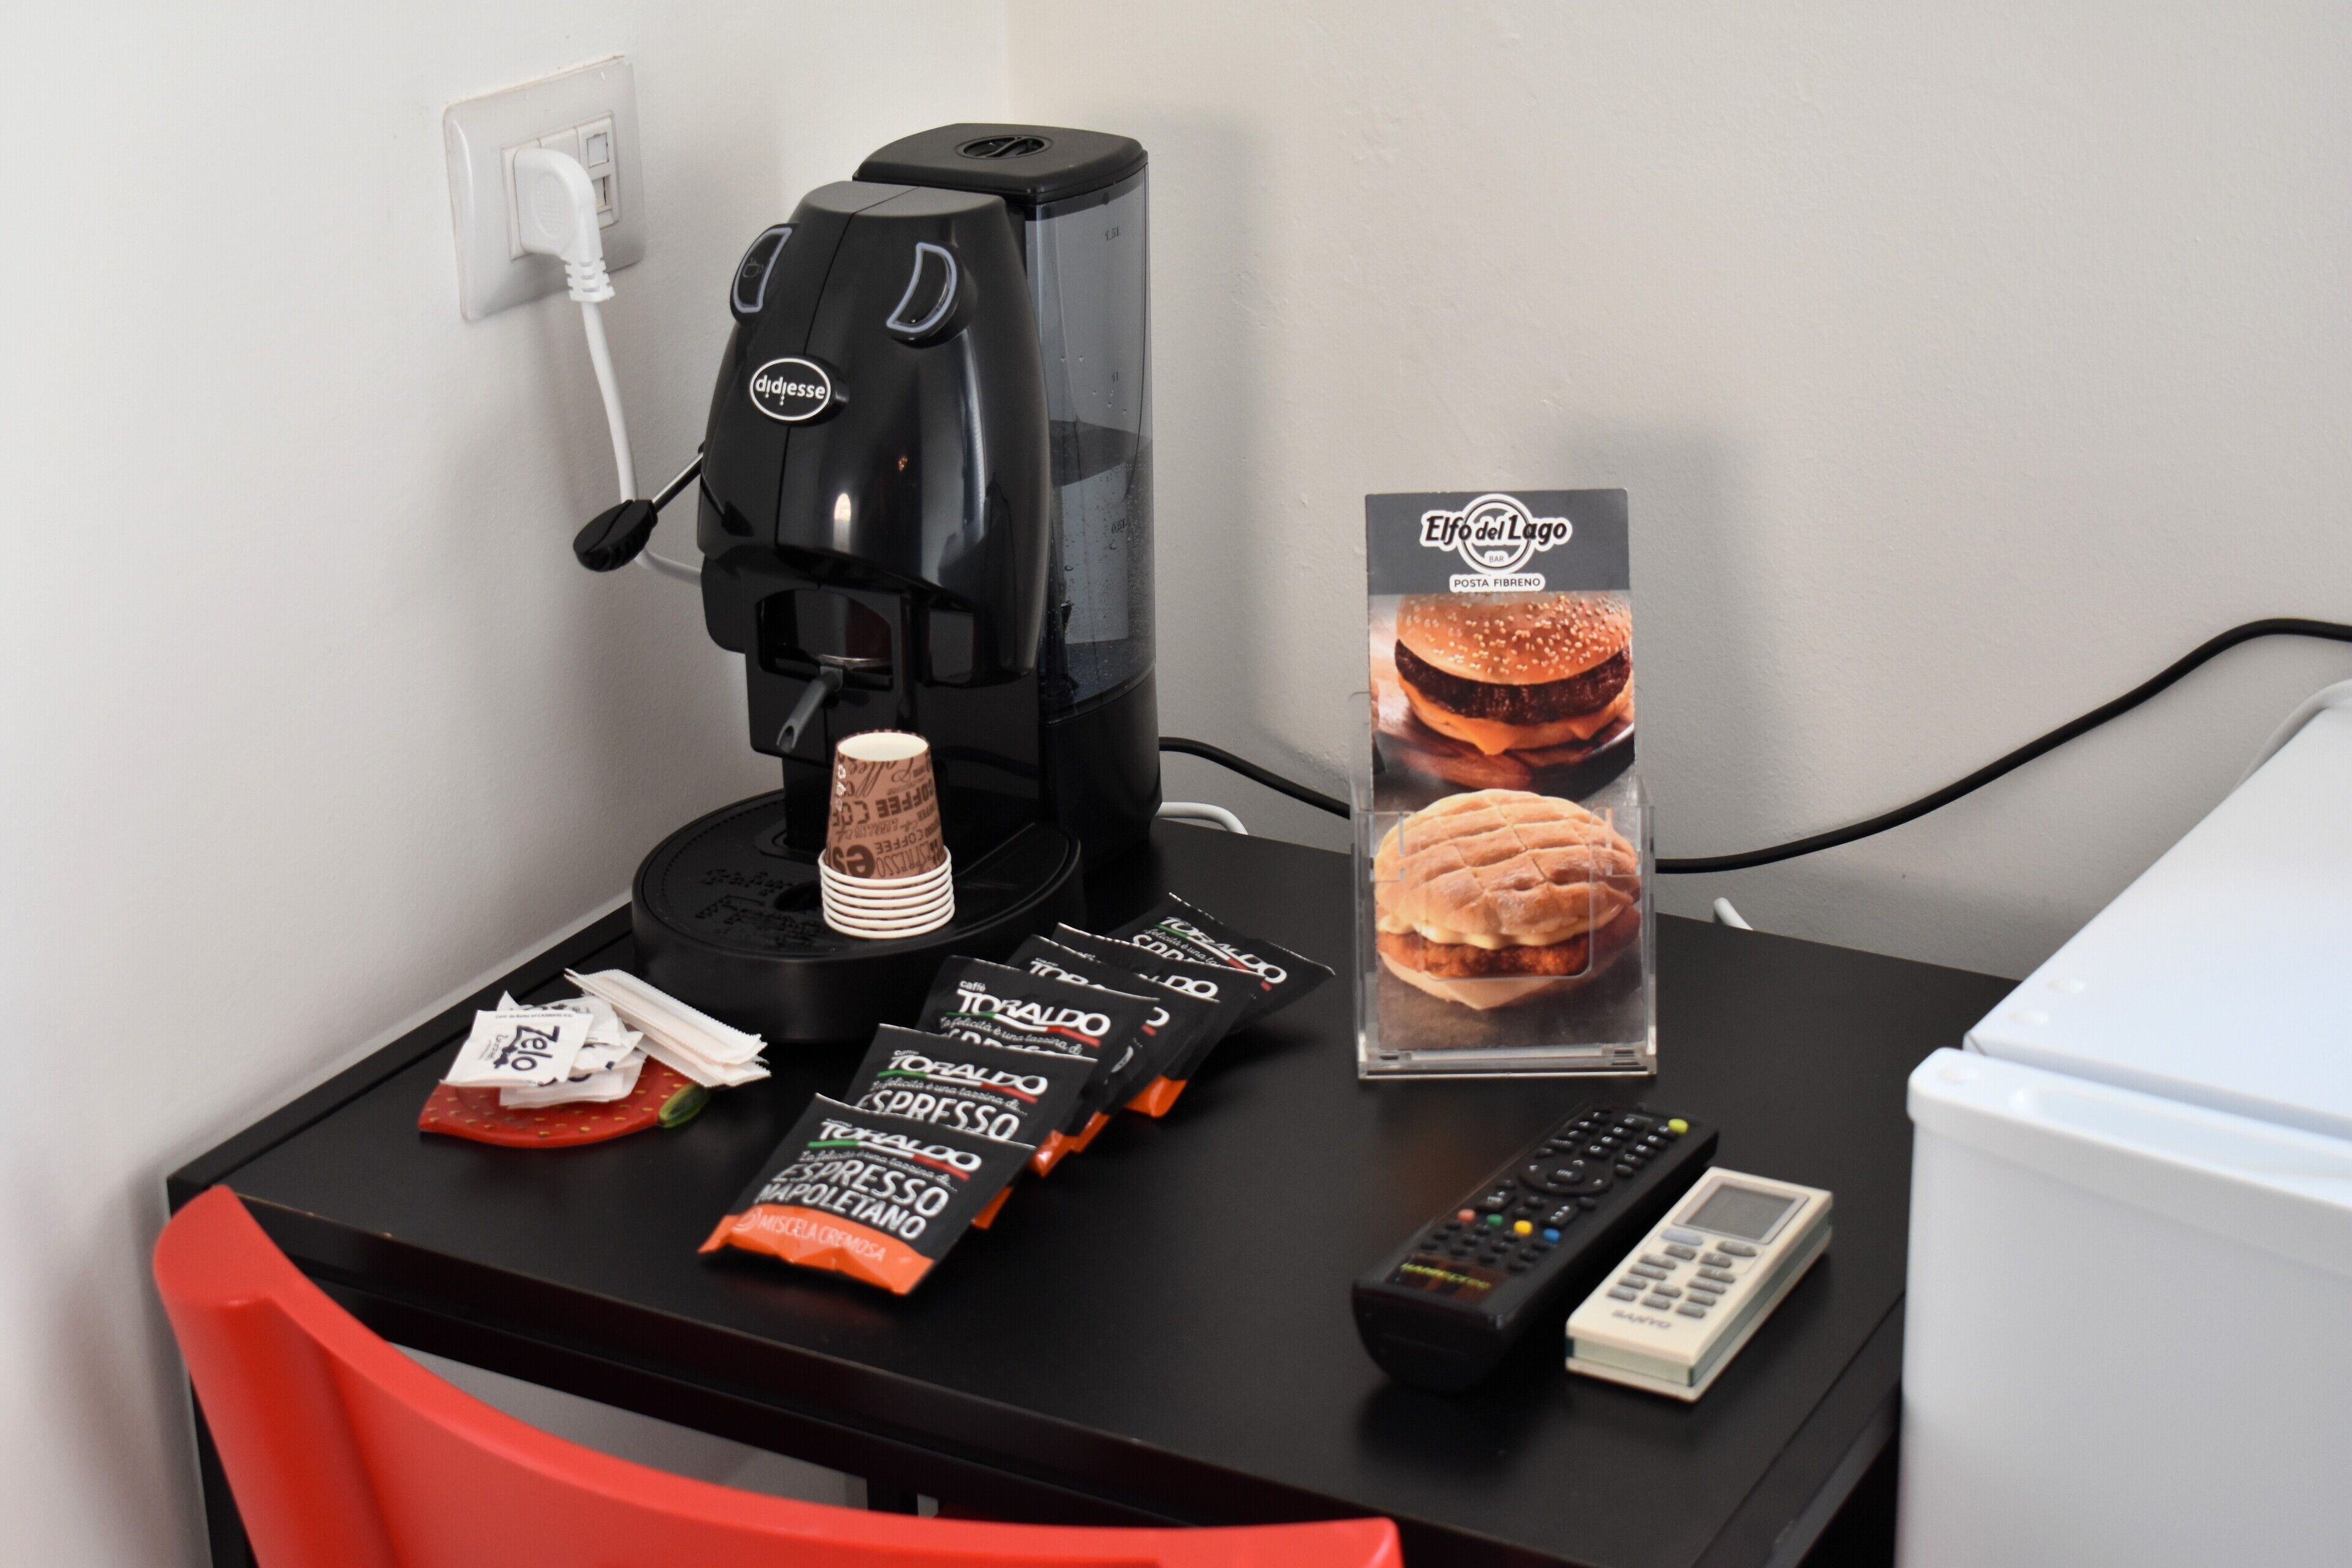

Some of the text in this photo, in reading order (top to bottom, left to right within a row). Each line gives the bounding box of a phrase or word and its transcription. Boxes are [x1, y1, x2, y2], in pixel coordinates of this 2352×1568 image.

[755, 374, 826, 406] didiesse
[1425, 514, 1567, 545] Elfo del Lago
[1454, 578, 1540, 588] POSTA FIBRENO
[874, 829, 924, 855] COFFEE
[1159, 919, 1287, 984] TORALDO
[959, 980, 986, 992] caffè
[956, 988, 1111, 1037] TORALDO
[888, 1054, 1049, 1096] TORALDO
[818, 1120, 982, 1172] TORALDO
[753, 1182, 927, 1240] NAPOLETANO
[771, 1159, 949, 1218] ESPRESSO
[759, 1213, 887, 1262] MISCELA CREMOSA
